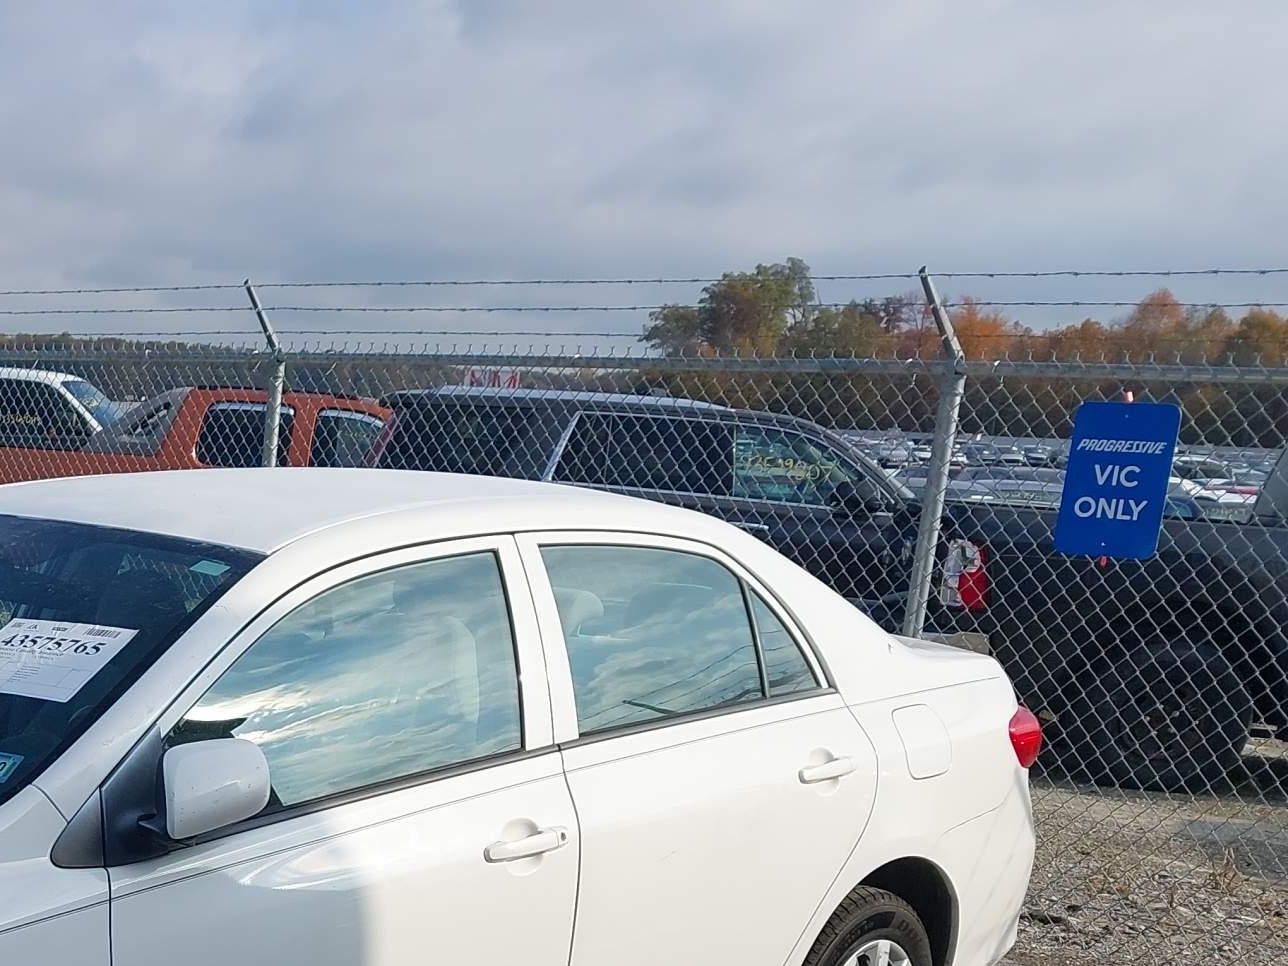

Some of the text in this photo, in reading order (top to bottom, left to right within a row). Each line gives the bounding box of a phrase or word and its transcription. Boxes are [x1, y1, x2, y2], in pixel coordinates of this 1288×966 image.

[1076, 438, 1168, 455] PROGRESSIVE
[1094, 463, 1142, 488] VIC
[1073, 496, 1149, 521] ONLY
[0, 633, 107, 656] 43575765
